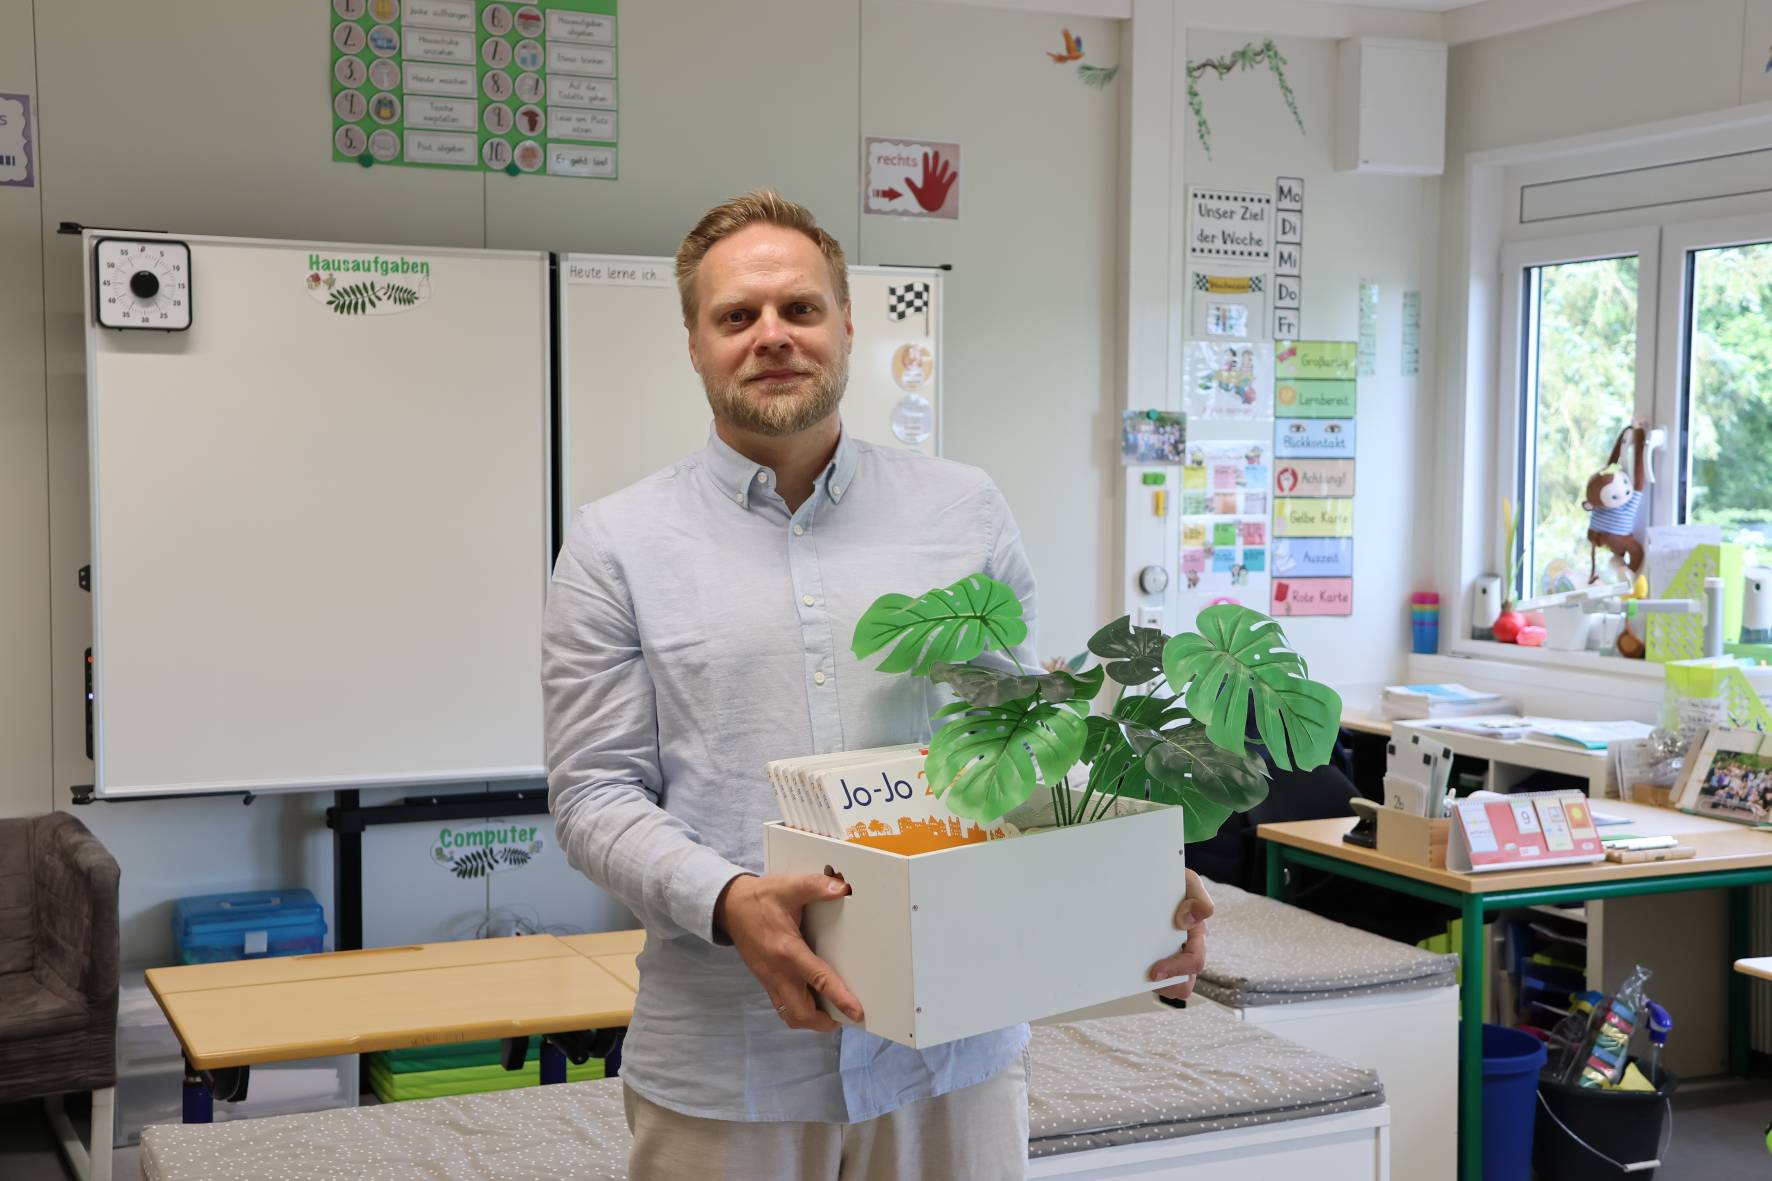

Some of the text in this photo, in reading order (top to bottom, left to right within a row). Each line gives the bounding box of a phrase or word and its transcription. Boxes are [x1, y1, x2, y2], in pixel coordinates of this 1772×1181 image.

[491, 7, 504, 29] 6.
[344, 25, 356, 47] 2.
[344, 60, 357, 81] 3.
[491, 73, 504, 94] 8.
[345, 128, 357, 150] 5.
[488, 140, 507, 162] 10.
[877, 152, 919, 168] rechts
[1279, 184, 1301, 203] Mo
[1197, 203, 1265, 221] Unser Ziel
[1281, 217, 1297, 236] Di
[1196, 228, 1265, 247] der Woche
[309, 253, 430, 276] Hausaufgaben
[1279, 250, 1297, 269] Mi
[570, 264, 602, 280] Heute
[607, 266, 637, 281] lerne
[1279, 283, 1298, 301] Do
[1278, 315, 1296, 333] Fr
[1292, 588, 1349, 603] Rote Karte
[840, 771, 914, 810] Jo-Jo
[439, 825, 538, 850] Computer
